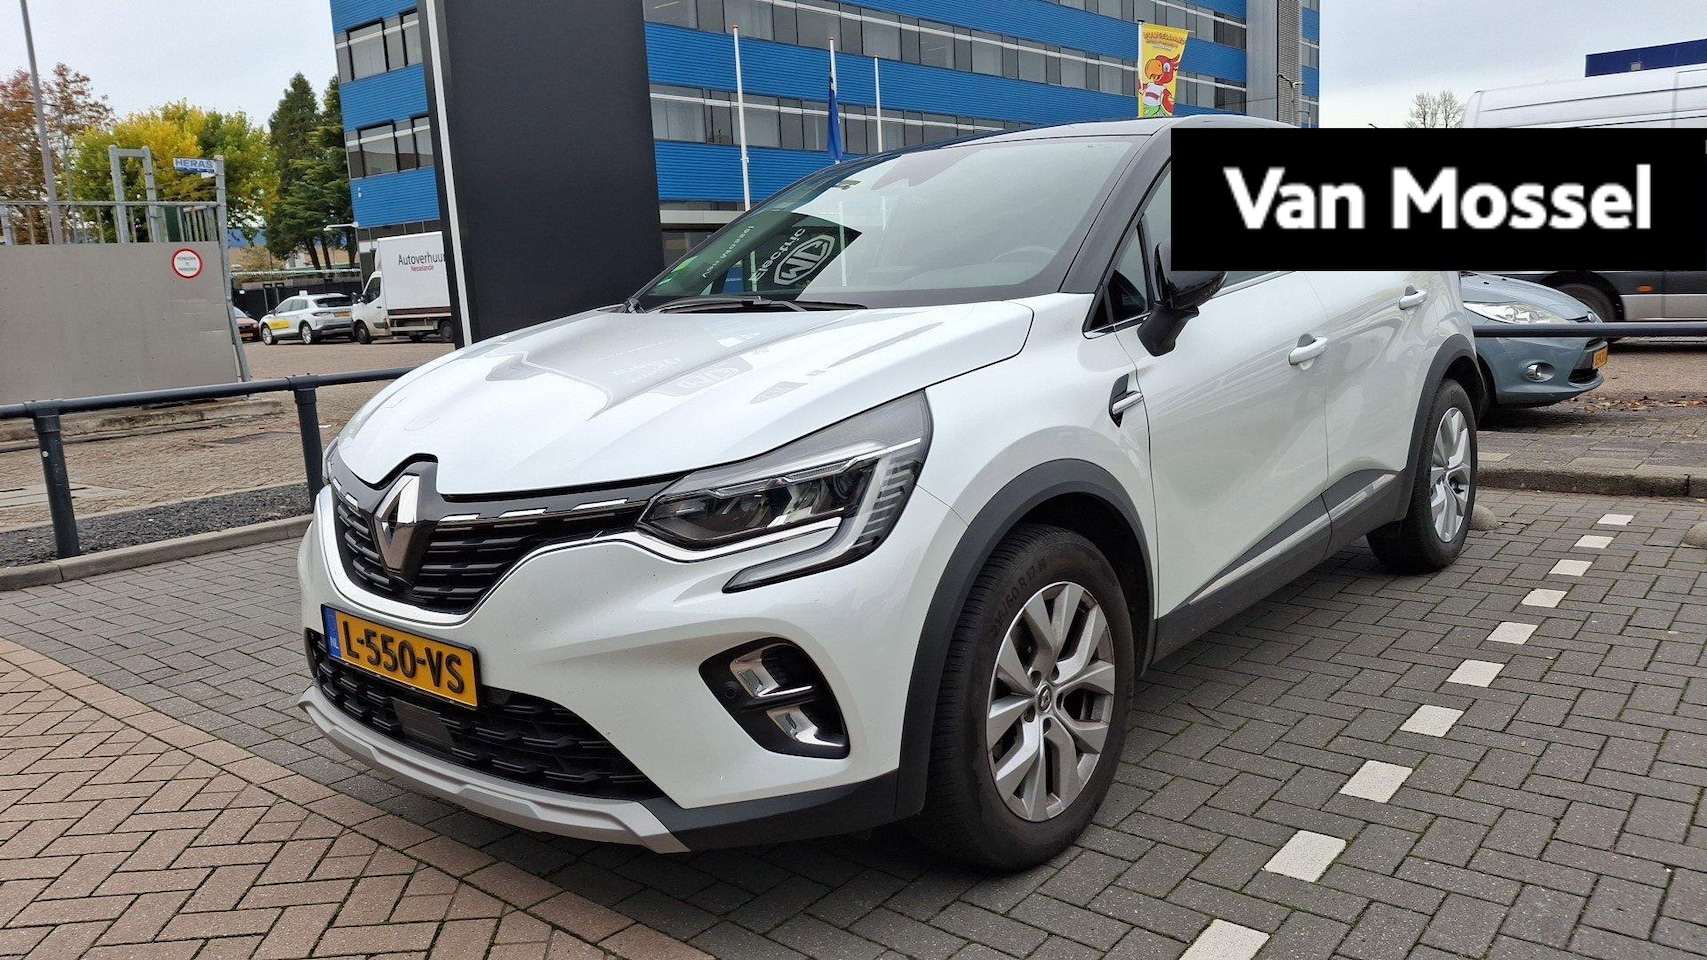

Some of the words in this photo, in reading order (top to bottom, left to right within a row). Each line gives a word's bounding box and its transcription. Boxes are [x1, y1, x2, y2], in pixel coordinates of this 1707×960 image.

[175, 159, 213, 168] HERAS
[329, 636, 340, 650] NL
[342, 620, 465, 694] L-550-VS
